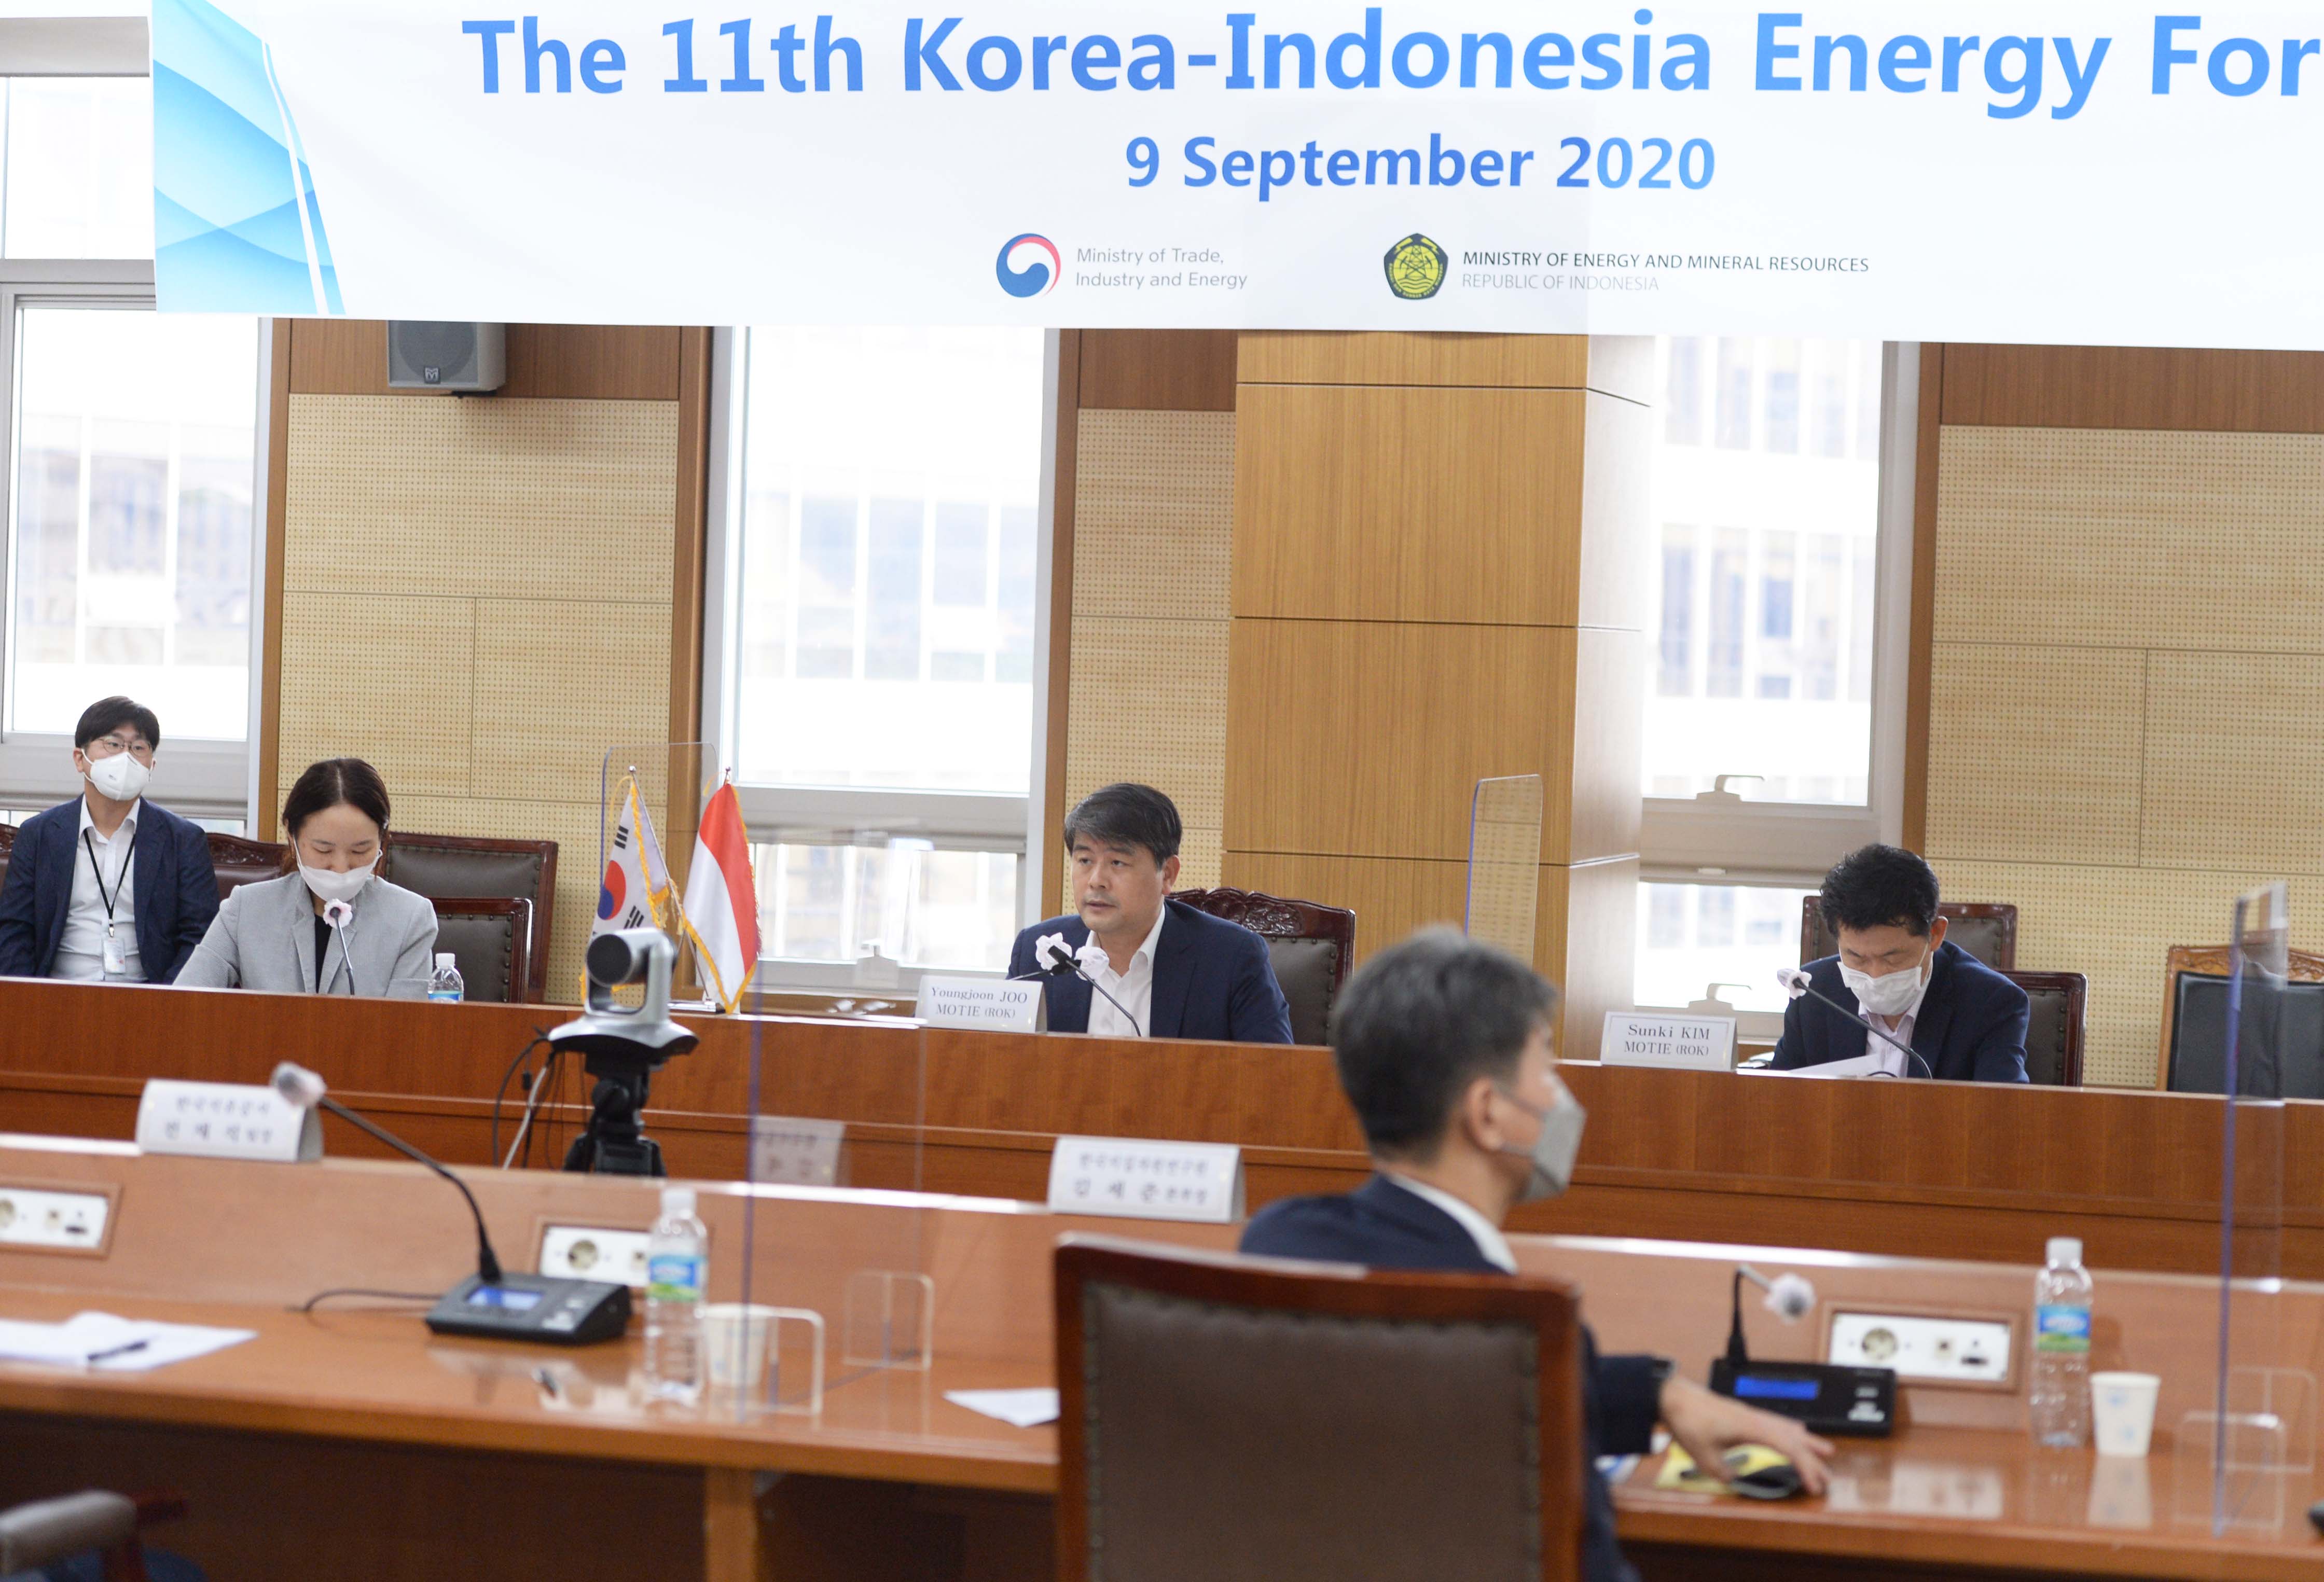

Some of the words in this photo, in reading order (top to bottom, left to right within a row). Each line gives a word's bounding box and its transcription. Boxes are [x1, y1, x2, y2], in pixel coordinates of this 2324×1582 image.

[462, 16, 626, 94] The
[662, 15, 863, 93] 11th
[904, 8, 1710, 92] Korea-Indonesia
[1755, 13, 2112, 120] Energy
[2152, 15, 2321, 97] For
[1127, 137, 1159, 187] 9
[1184, 133, 1534, 202] September
[1556, 137, 1714, 190] 2020
[1077, 247, 1144, 266] Ministry
[1149, 247, 1166, 262] of
[1171, 247, 1224, 265] Trade,
[1463, 251, 1542, 266] MINISTRY
[1546, 252, 1569, 267] OF
[1574, 253, 1640, 268] ENERGY
[1645, 254, 1683, 269] AND
[1688, 255, 1764, 270] MINERAL
[1769, 256, 1869, 272] RESOURCES
[1076, 272, 1145, 290] Industry
[1150, 271, 1182, 287] and
[1188, 272, 1248, 290] Energy
[1462, 273, 1539, 289] REPUBLIC
[1543, 274, 1565, 290] OF
[1569, 275, 1659, 291] INDONESIA
[932, 987, 994, 1001] Youngjoon
[1000, 991, 1028, 1004] JOO
[937, 1004, 981, 1017] MOTIE
[985, 1008, 1016, 1019] (ROK)
[1628, 1023, 1673, 1037] Sunki
[1681, 1026, 1710, 1040] KIM
[1624, 1041, 1672, 1055] MOTIE
[1676, 1045, 1709, 1057] (ROK)
